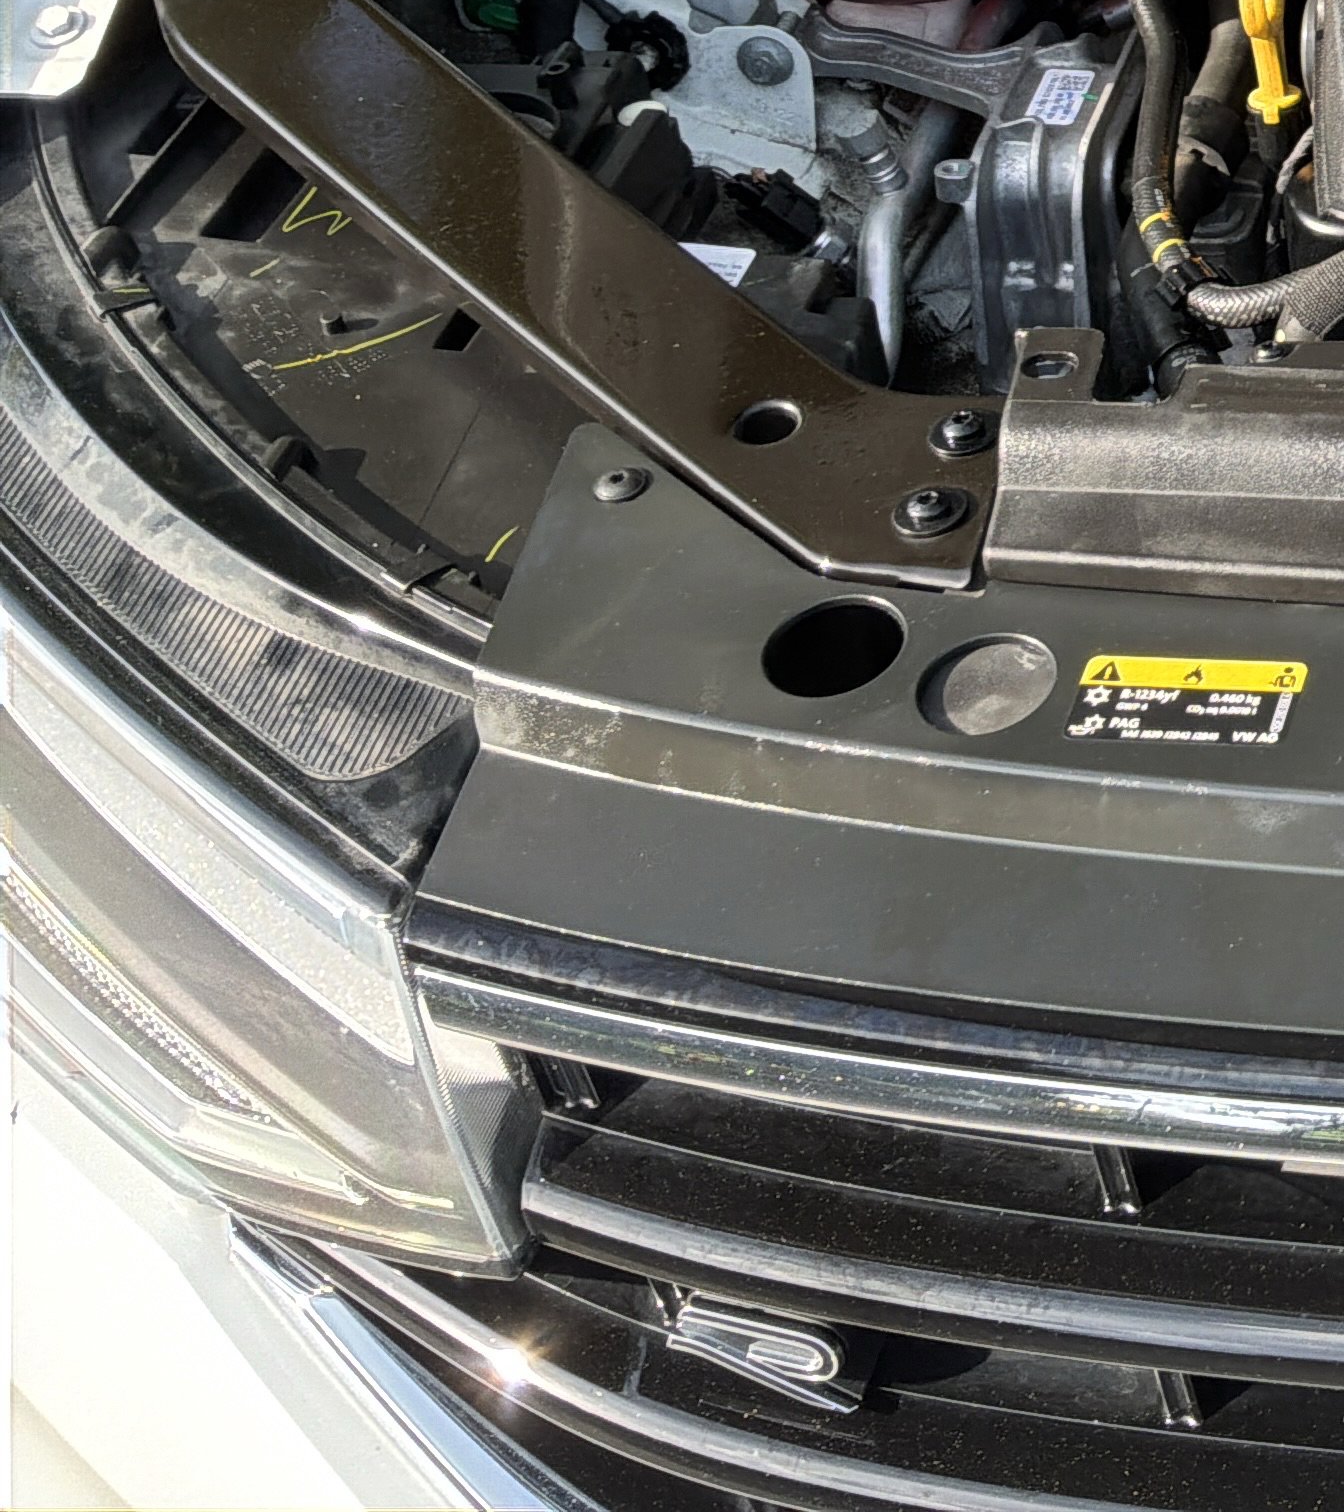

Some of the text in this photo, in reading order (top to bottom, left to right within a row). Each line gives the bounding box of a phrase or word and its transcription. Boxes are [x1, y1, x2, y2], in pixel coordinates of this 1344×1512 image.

[1245, 694, 1262, 707] kg
[1108, 717, 1141, 728] PAG
[1232, 731, 1256, 743] VW
[1256, 731, 1279, 744] AG
